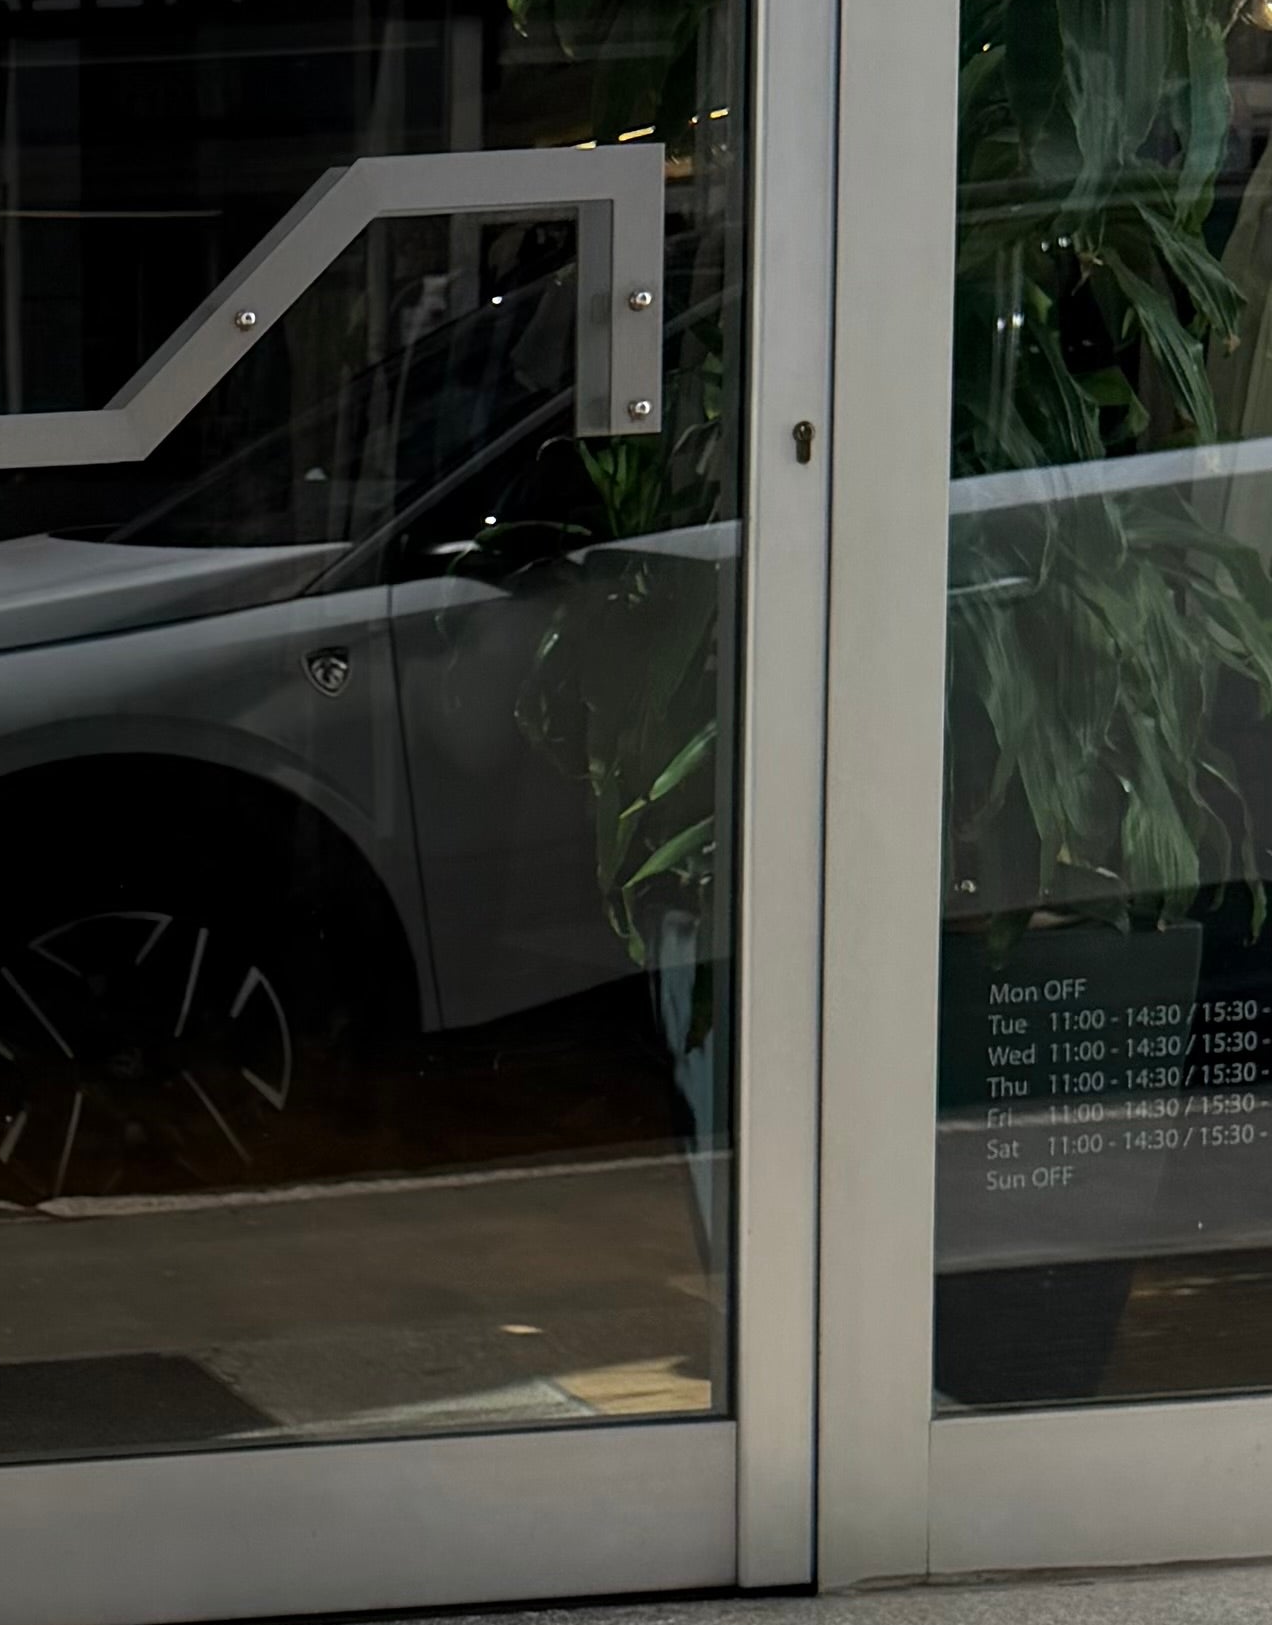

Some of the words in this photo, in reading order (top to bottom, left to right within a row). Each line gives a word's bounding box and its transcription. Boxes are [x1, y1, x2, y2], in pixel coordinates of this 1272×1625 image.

[989, 984, 1038, 1004] Mon
[1044, 978, 1087, 1001] OFF
[988, 1014, 1028, 1035] Tue
[1049, 1009, 1105, 1032] 11:00
[1125, 1004, 1181, 1027] 14:30
[1187, 1002, 1197, 1024] /
[1202, 999, 1257, 1022] 15:30
[988, 1044, 1036, 1066] Wed
[1050, 1040, 1105, 1063] 11:00
[1125, 1035, 1181, 1058] 14:30
[1185, 1034, 1196, 1055] /
[1202, 1030, 1257, 1053] 15:30
[987, 1076, 1028, 1098] Thu
[1049, 1071, 1105, 1094] 11:00
[1125, 1066, 1180, 1089] 14:30
[1184, 1065, 1195, 1086] /
[1201, 1062, 1257, 1085] 15:30
[986, 1108, 1012, 1128] Fri
[1049, 1103, 1104, 1125] 11:00
[1124, 1098, 1179, 1121] 14:30
[1184, 1096, 1194, 1117] /
[1201, 1093, 1256, 1116] 15:30
[986, 1139, 1020, 1160] Sat
[1048, 1134, 1103, 1157] 11:00
[1123, 1129, 1179, 1151] 14:30
[1183, 1127, 1194, 1149] /
[1200, 1124, 1254, 1147] 15:30
[986, 1170, 1025, 1191] Sun
[1032, 1166, 1074, 1188] OFF
